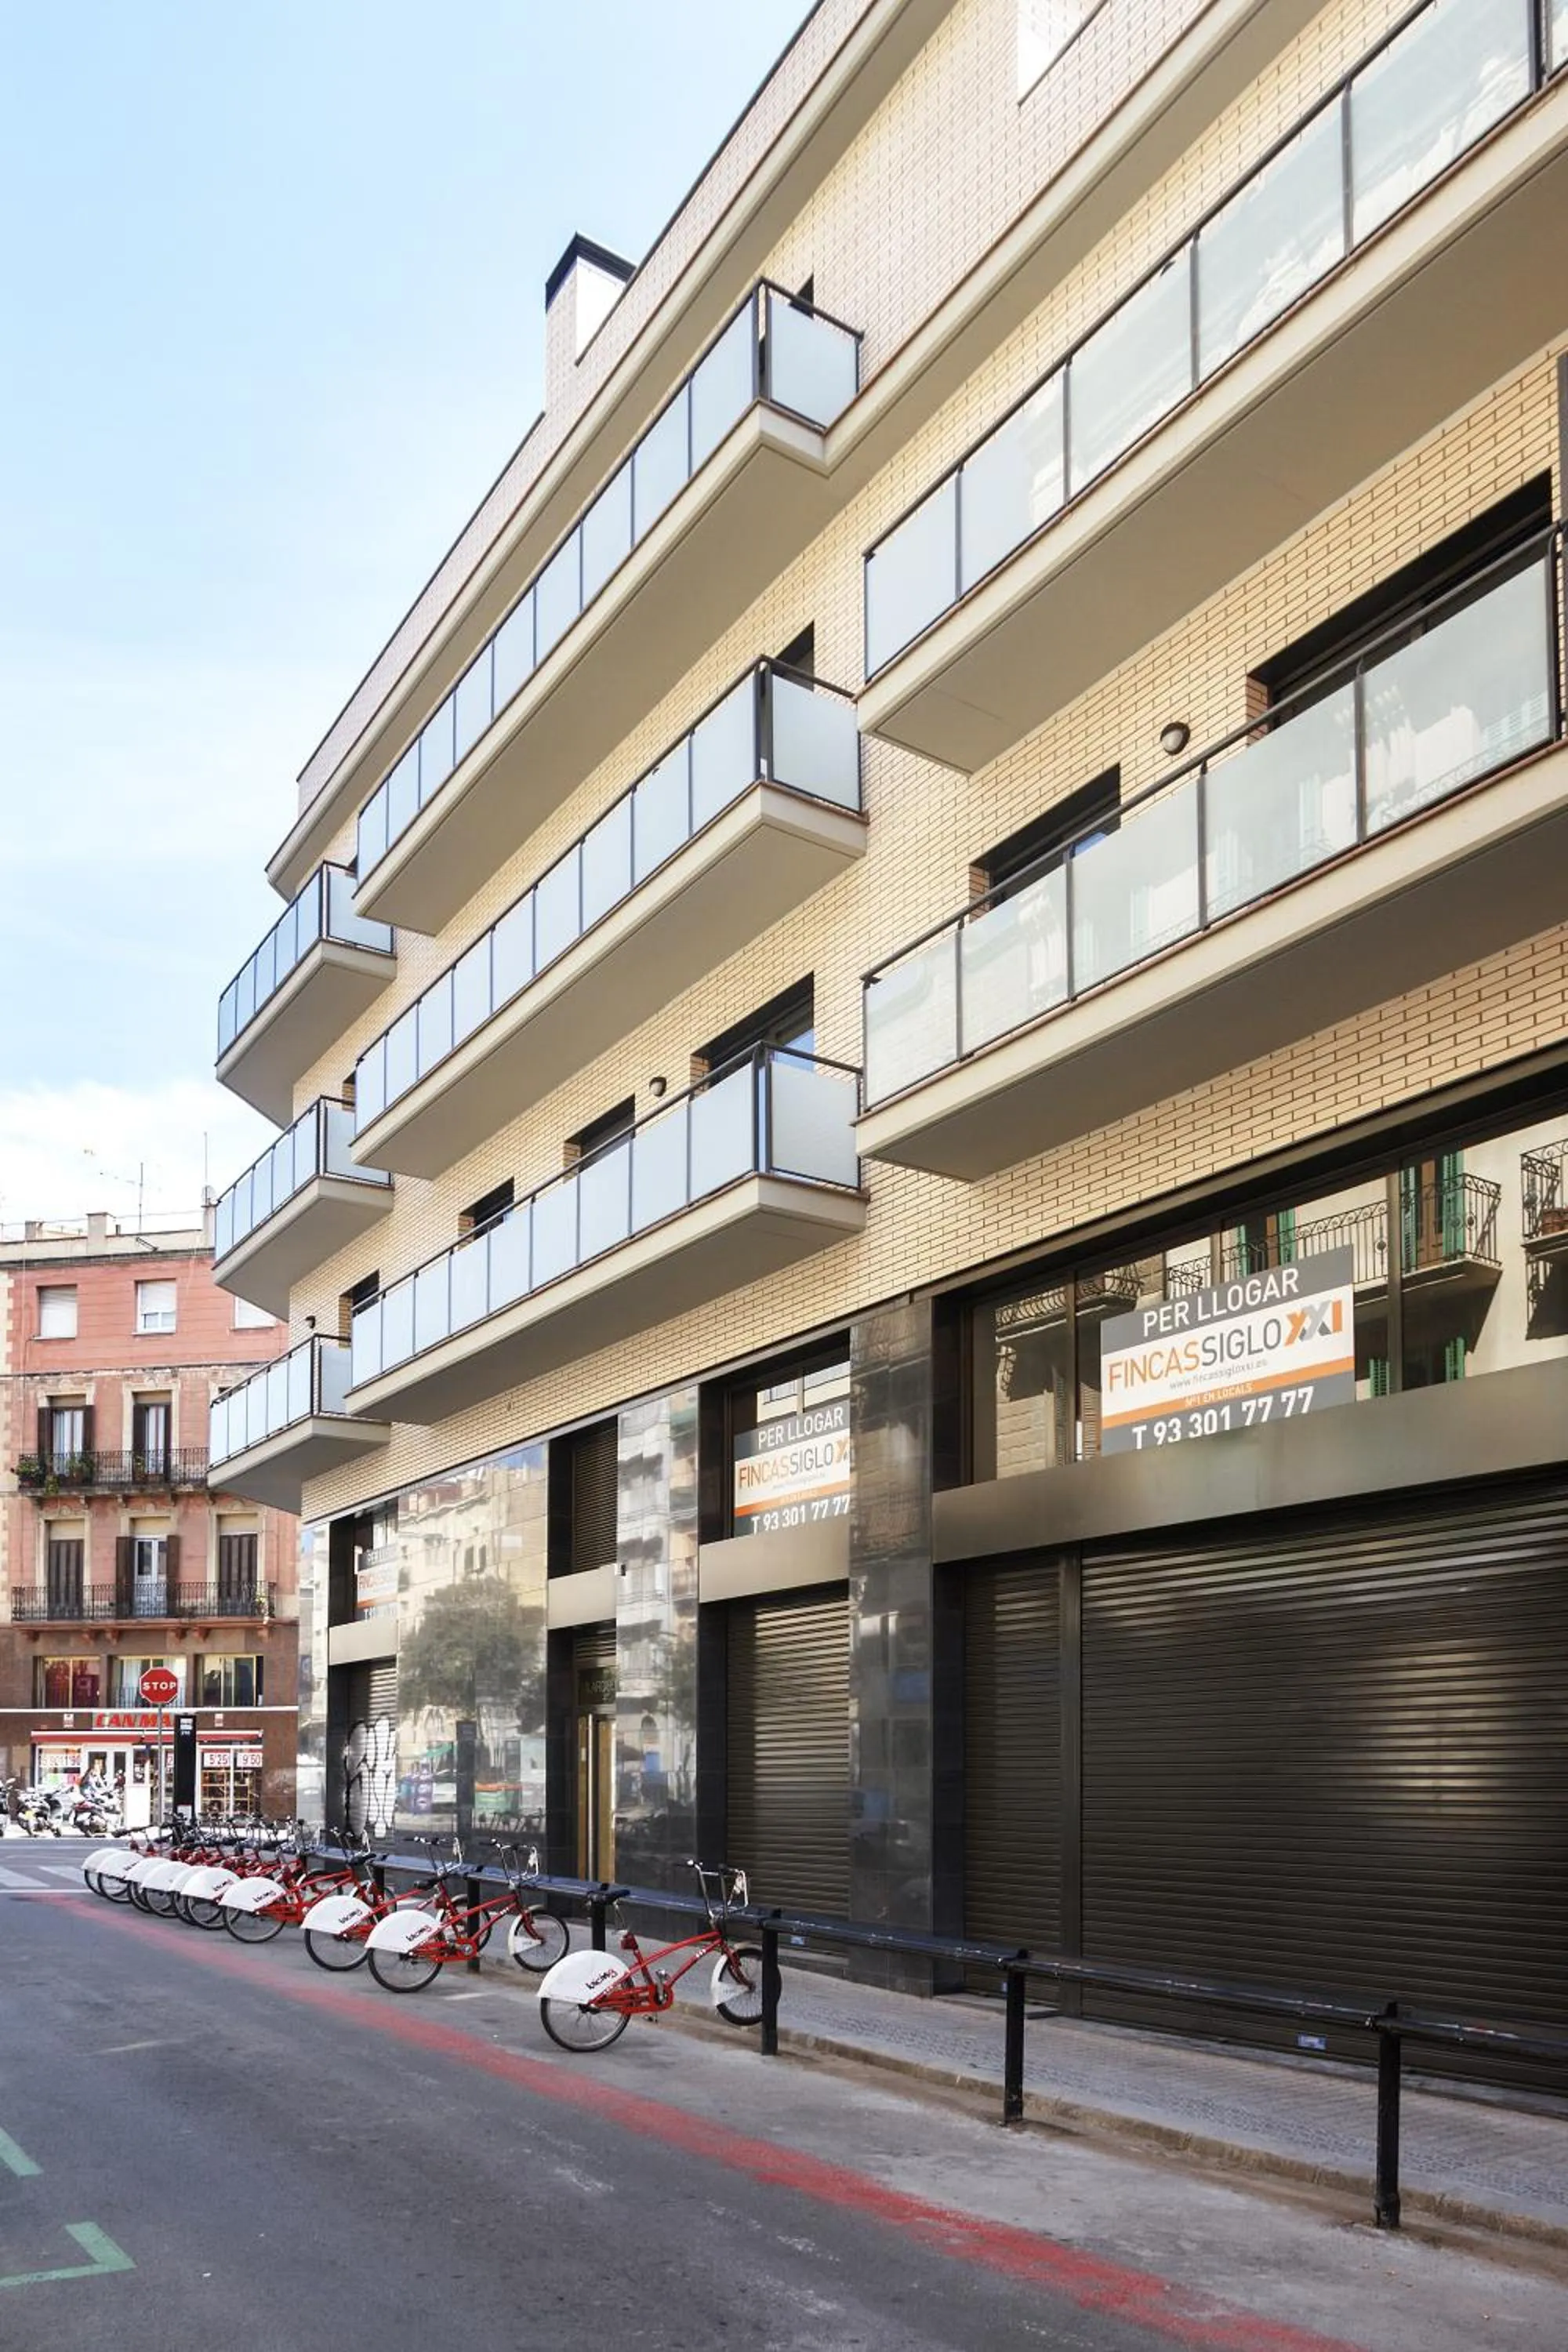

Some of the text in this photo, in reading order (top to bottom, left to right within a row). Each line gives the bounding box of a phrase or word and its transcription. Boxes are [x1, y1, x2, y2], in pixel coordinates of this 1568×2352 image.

[1143, 1268, 1299, 1337] PER LLOGAR
[1217, 1381, 1254, 1398] LOCALS
[758, 1406, 844, 1450] PER LLOGAR
[1131, 1385, 1314, 1450] T 93 301 77 77
[750, 1515, 761, 1536] T
[764, 1510, 779, 1531] 93
[782, 1504, 806, 1528] 301
[811, 1498, 829, 1520] 77
[833, 1494, 850, 1516] 77
[142, 1681, 176, 1691] STOP
